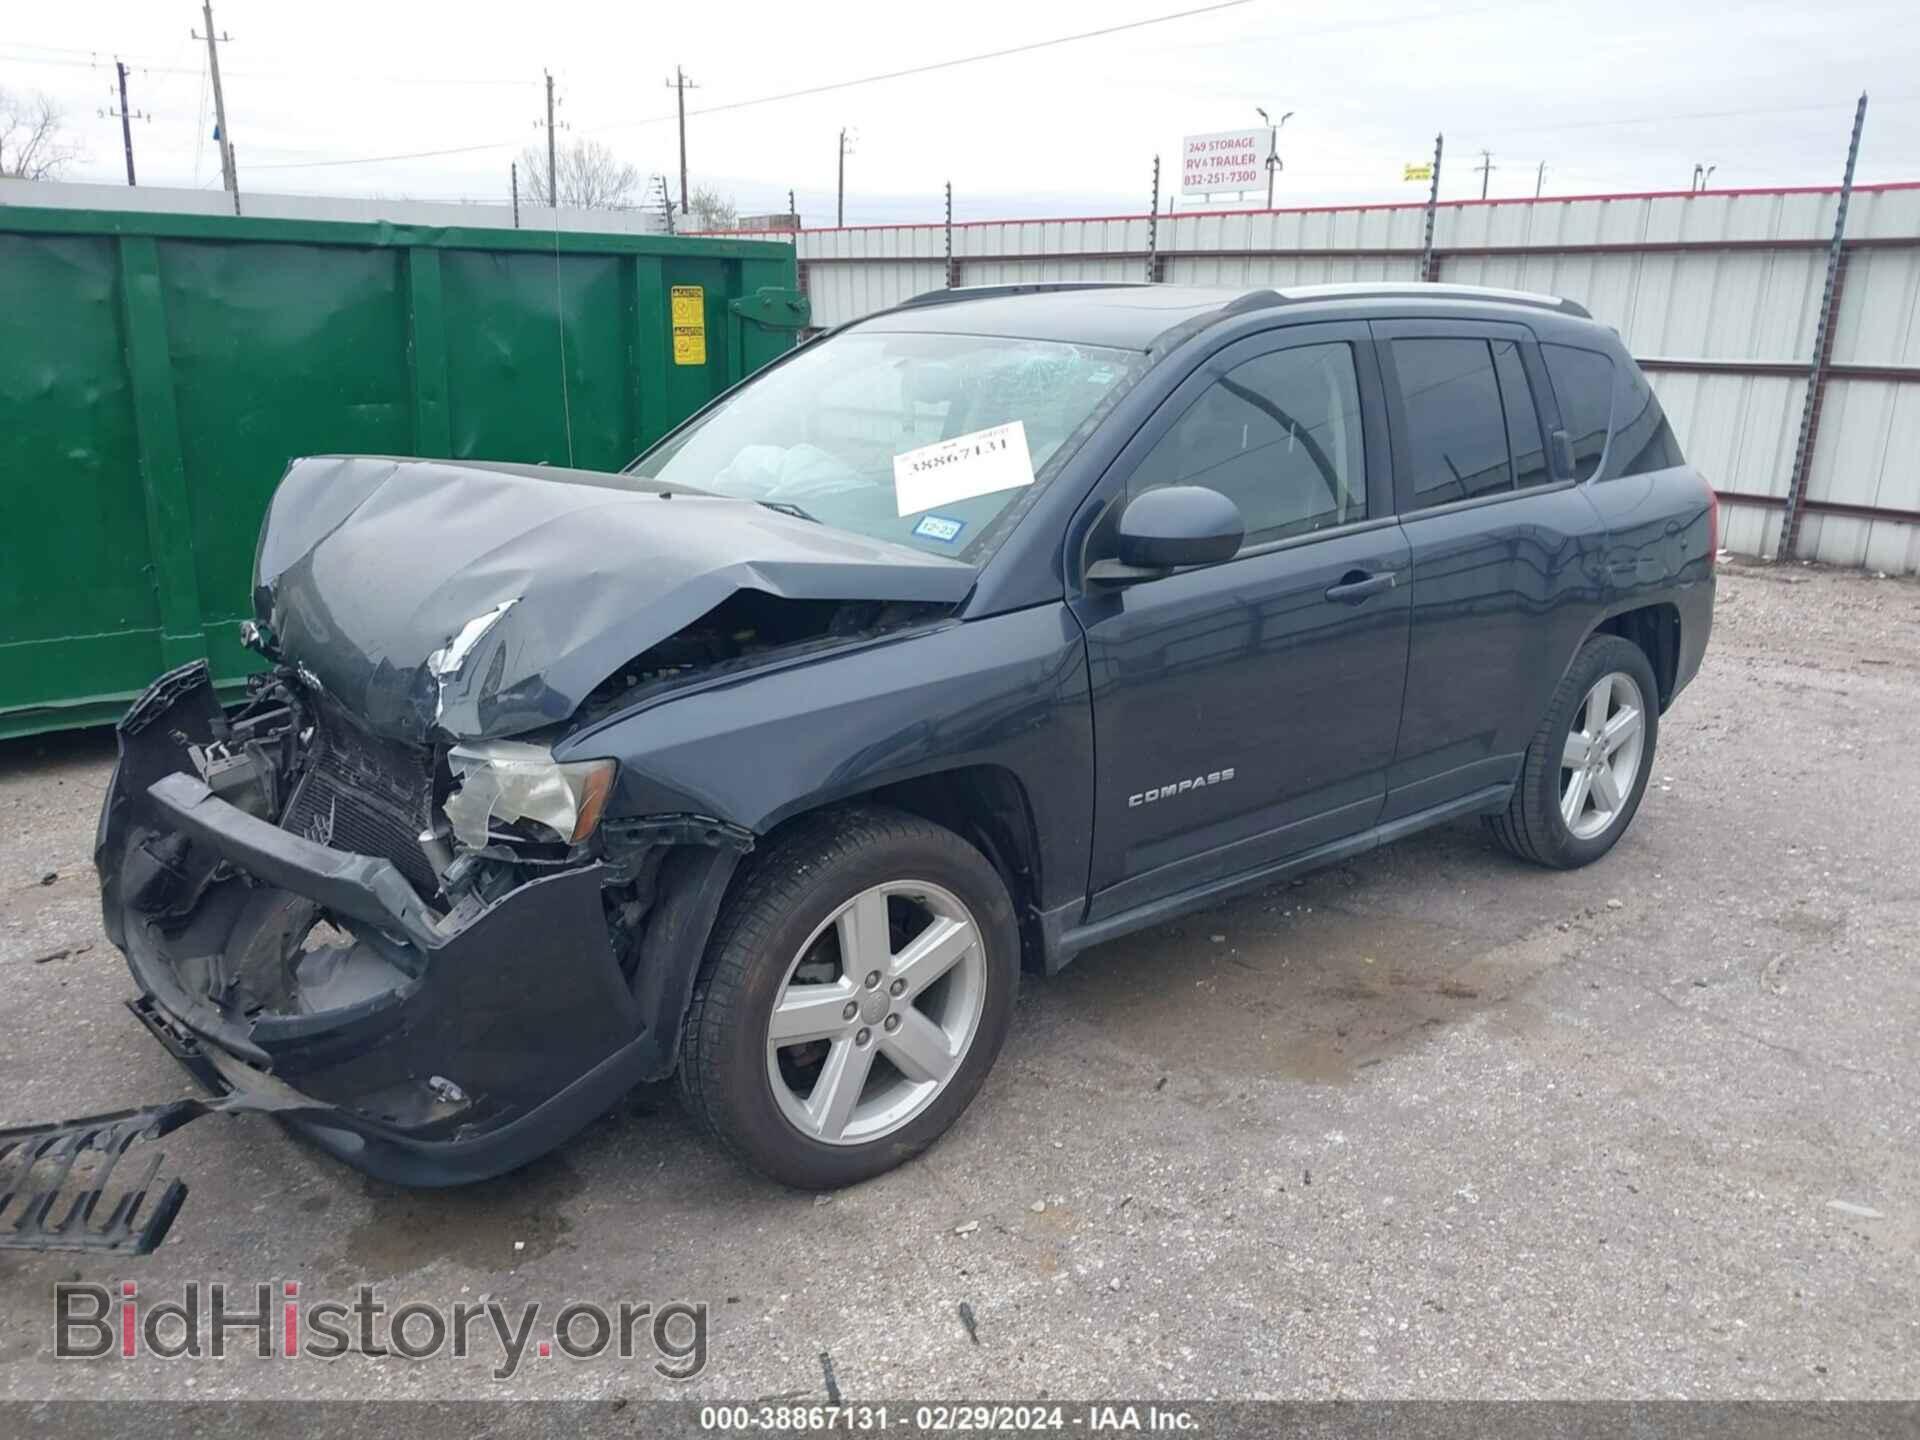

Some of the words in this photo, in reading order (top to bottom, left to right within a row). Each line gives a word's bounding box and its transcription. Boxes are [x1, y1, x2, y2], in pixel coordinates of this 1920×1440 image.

[1208, 137, 1256, 151] STORAGE
[1186, 158, 1201, 169] RV
[1209, 153, 1256, 167] TRAILER
[1128, 767, 1235, 808] COMPASS
